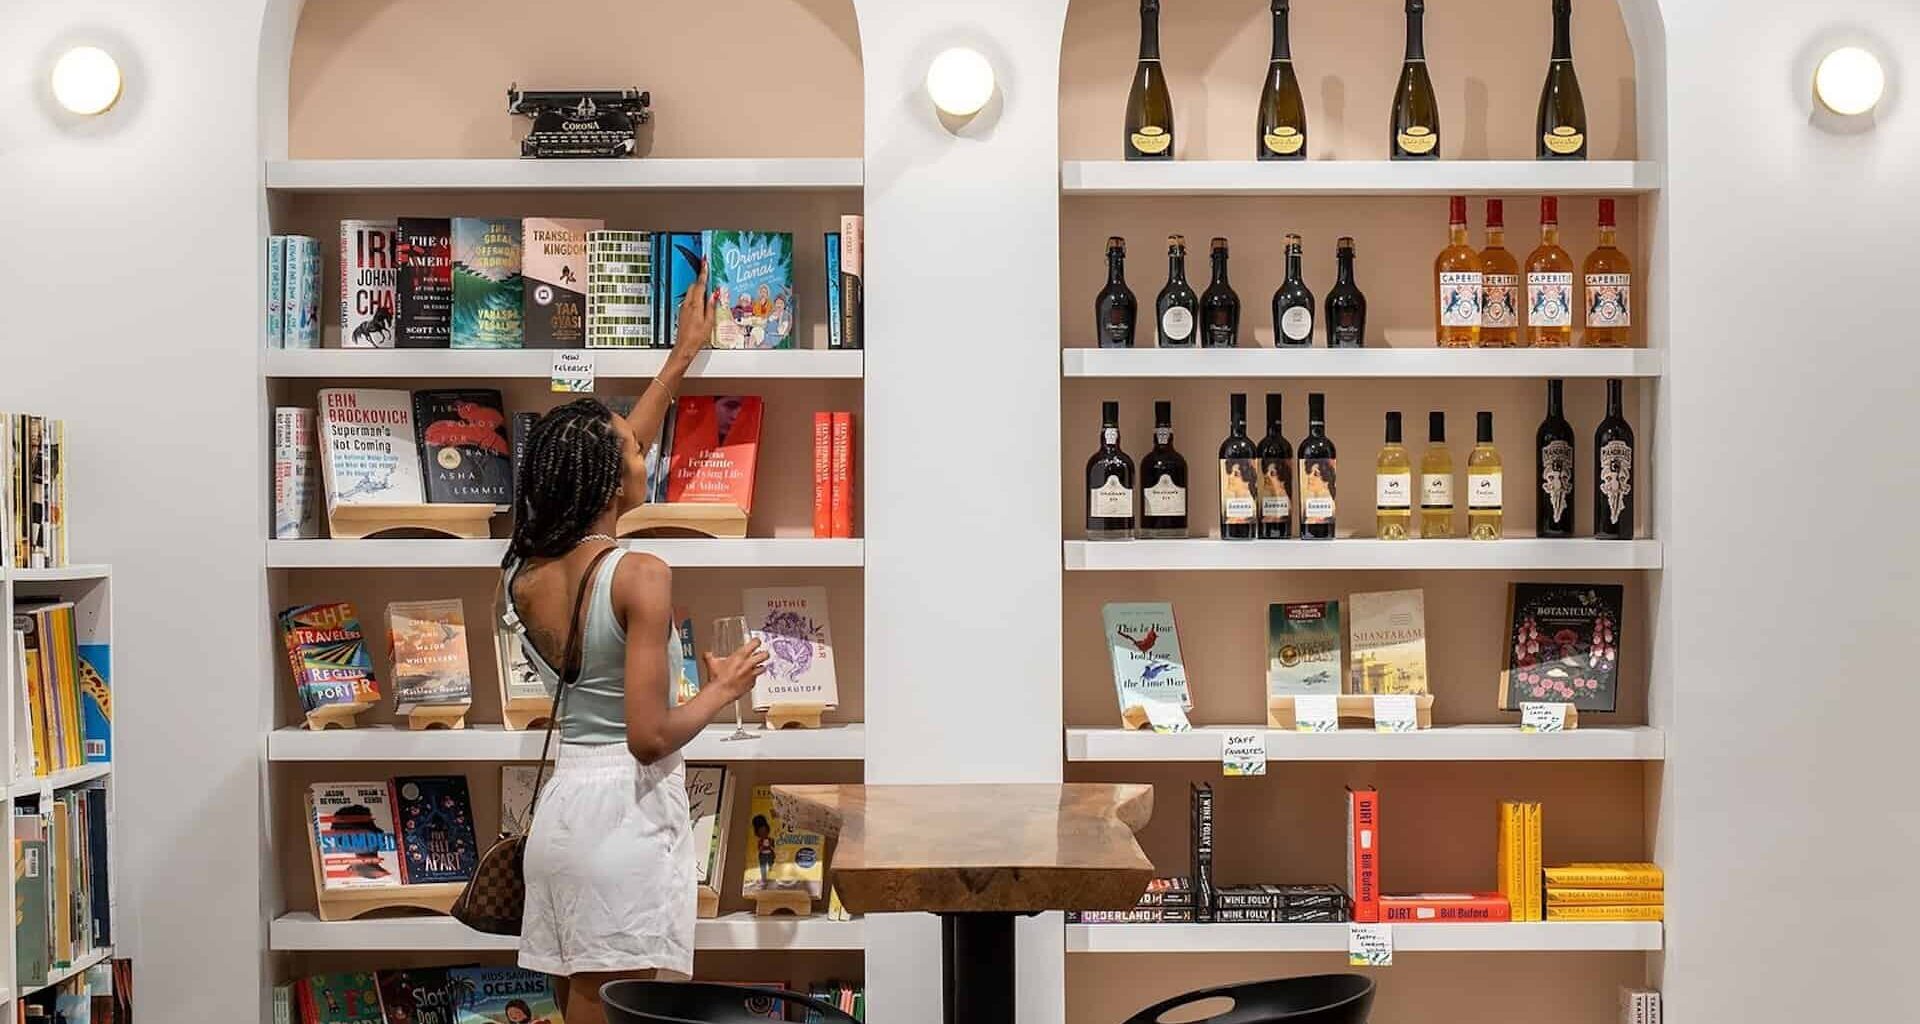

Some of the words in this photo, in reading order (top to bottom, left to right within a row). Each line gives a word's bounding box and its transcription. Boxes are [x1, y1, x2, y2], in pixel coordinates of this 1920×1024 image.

[562, 121, 600, 131] CORONA
[410, 236, 437, 246] THE
[407, 256, 450, 268] AMERI
[726, 244, 776, 270] Drinks
[357, 269, 396, 286] JOHAN
[736, 258, 775, 284] Lanai
[356, 289, 394, 316] CHA
[406, 326, 432, 334] SCOTT
[561, 354, 580, 362] new
[328, 394, 356, 408] ERIN
[432, 404, 472, 413] FIFTY
[329, 408, 408, 424] BROCKOVICH
[331, 424, 392, 438] Superman's
[334, 440, 350, 450] Not
[354, 440, 392, 454] Coming
[688, 458, 734, 468] Ferrante
[440, 472, 475, 480] ASHA
[454, 486, 504, 494] LEMMIE
[768, 599, 808, 608] RUTHIE
[311, 603, 352, 624] THE
[1536, 606, 1597, 616] BOTANICUM
[1116, 623, 1138, 634] This
[1352, 628, 1422, 642] SHANTARAM
[296, 630, 361, 645] TRAVELERS
[312, 668, 366, 682] REGINA
[318, 678, 374, 700] PORTER
[768, 684, 822, 694] LOSKUTOFF
[1124, 679, 1139, 689] the
[1142, 680, 1164, 688] Time
[1166, 678, 1186, 688] War
[1228, 736, 1256, 745] STAFF
[1224, 748, 1264, 756] FAVORITES
[320, 797, 351, 805] REYNOLDS
[1203, 799, 1211, 820] WINE
[1360, 800, 1372, 824] DIRT
[320, 832, 396, 850] STAMPED
[1203, 822, 1211, 846] FOLLY
[425, 852, 460, 871] APART
[1362, 854, 1372, 868] Bill
[1362, 870, 1372, 902] Buford
[1224, 896, 1246, 905] WINE
[1248, 896, 1272, 904] FOLLY
[1222, 910, 1242, 919] WINE
[1246, 910, 1270, 919] FOLLY
[1388, 908, 1411, 920] DIRT
[1440, 907, 1456, 918] Bill
[1458, 907, 1488, 918] Buford
[483, 980, 544, 995] OCEANS
